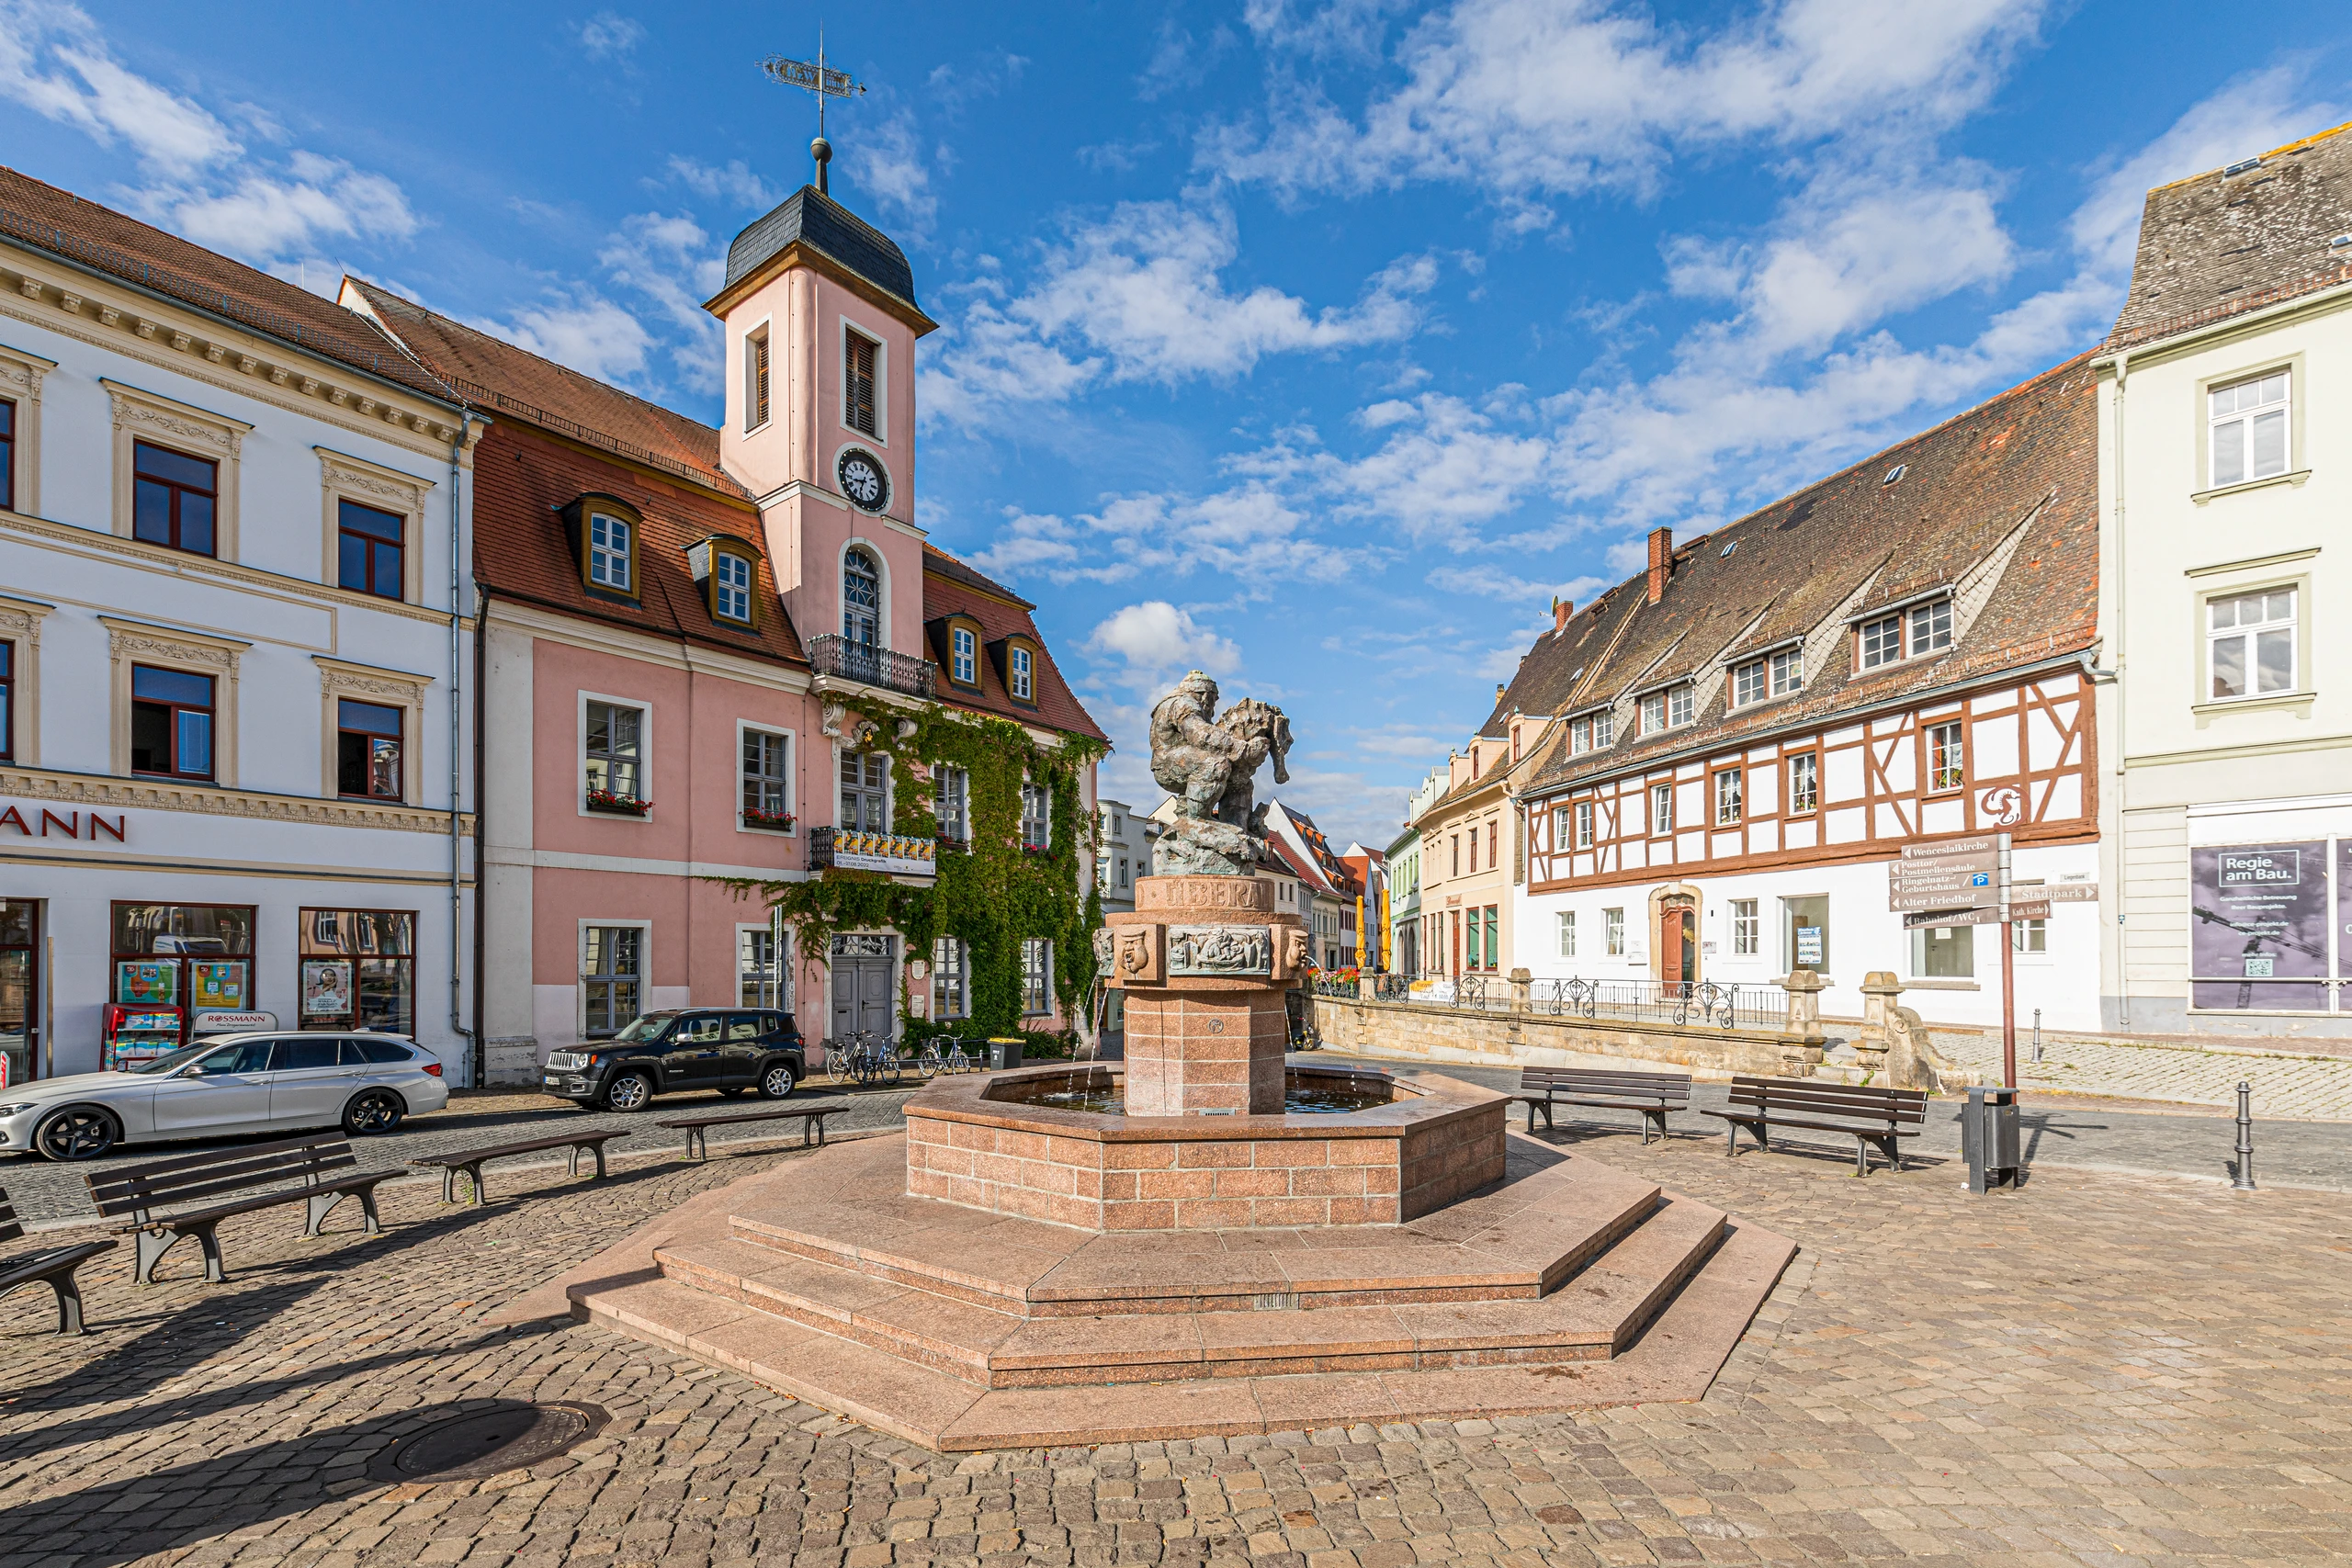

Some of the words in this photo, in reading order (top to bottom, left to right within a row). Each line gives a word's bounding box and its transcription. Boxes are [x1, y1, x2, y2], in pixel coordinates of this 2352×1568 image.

[0, 806, 125, 842] ANN
[1913, 841, 1988, 856] Wenceslaikirche
[1901, 859, 1939, 869] Posttor/
[1902, 864, 1975, 875] Postmeilensäule
[2226, 857, 2273, 870] Regie
[2226, 872, 2252, 881] am
[2256, 868, 2292, 880] Bau.
[1902, 883, 1960, 893] Geburtshaus
[2021, 889, 2083, 899] Stadtpark
[1902, 897, 1928, 907] Alter
[1930, 894, 1976, 905] Friedhof
[2012, 908, 2025, 917] Kath.
[2027, 905, 2044, 915] Kirche
[1914, 912, 1974, 925] Bahnhof/WC
